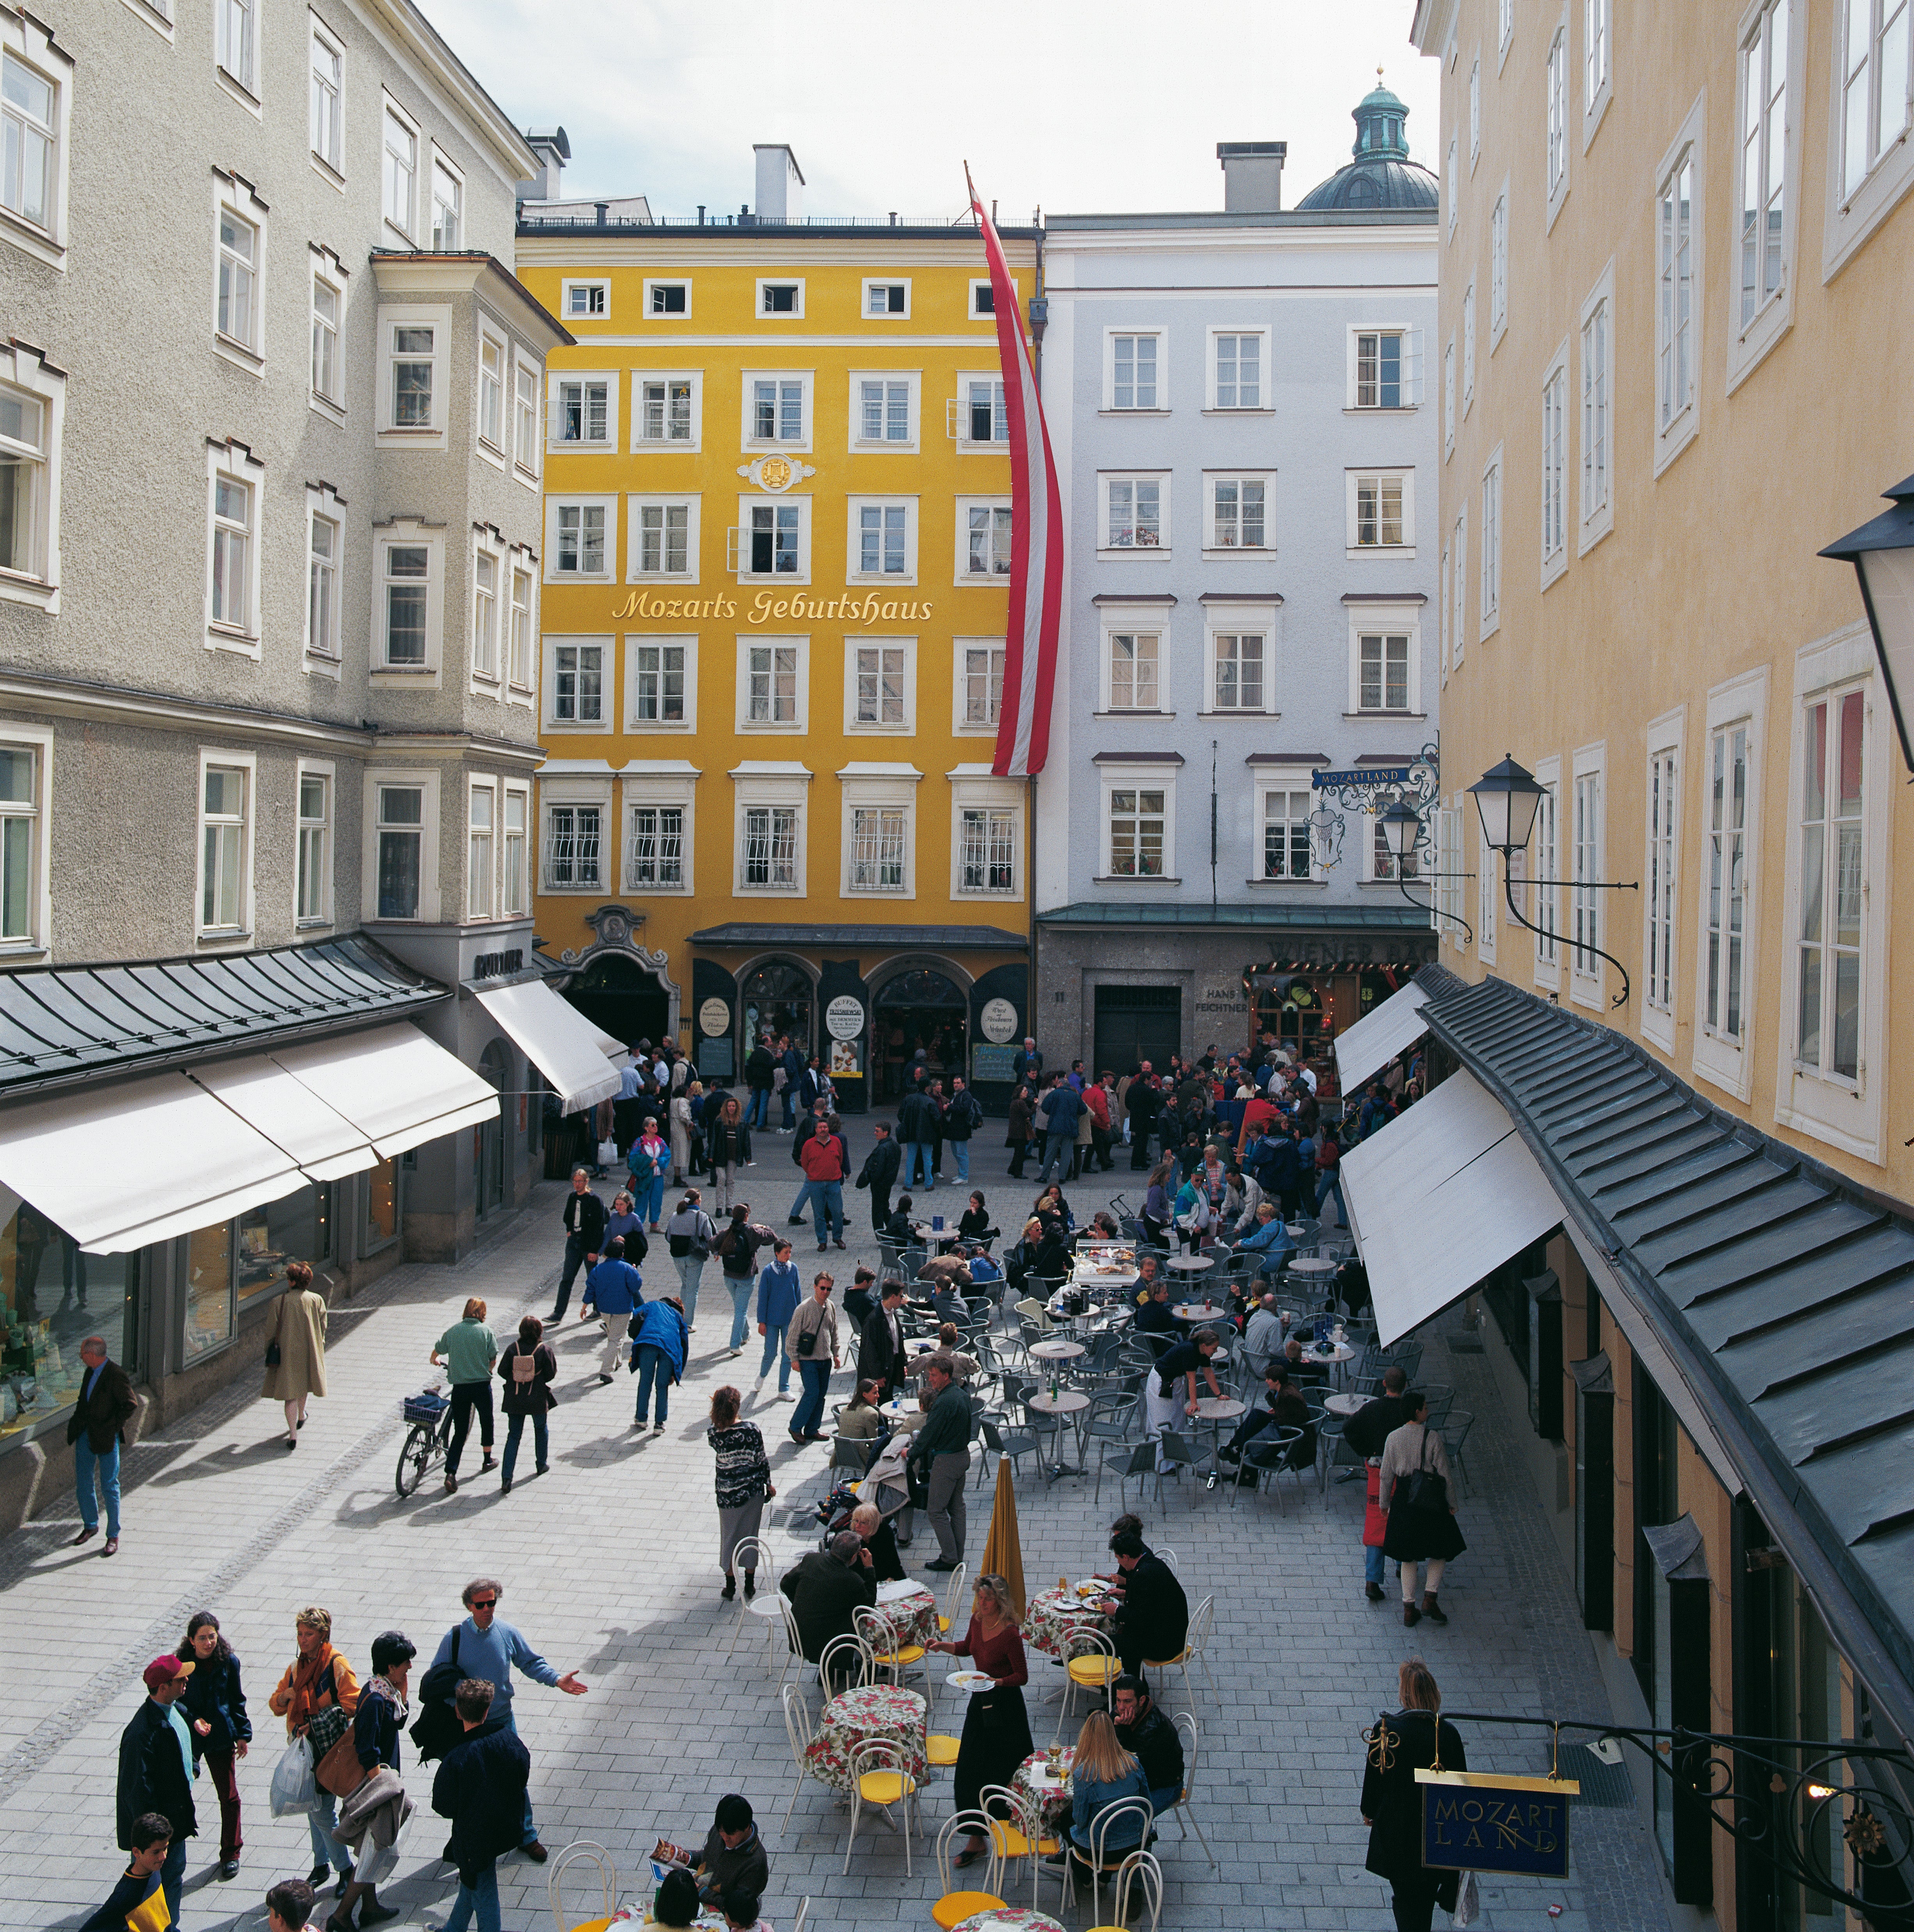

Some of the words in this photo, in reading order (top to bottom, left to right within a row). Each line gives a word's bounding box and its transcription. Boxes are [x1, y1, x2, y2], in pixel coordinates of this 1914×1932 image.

[612, 591, 737, 618] Mozarts
[747, 590, 933, 626] Geburtshaus
[1268, 941, 1373, 964] WIENER
[1055, 991, 1064, 1002] 11
[1207, 989, 1235, 999] HANS
[834, 999, 858, 1008] BUFFET
[1195, 1003, 1247, 1012] FEICHTNER
[1435, 1798, 1558, 1828] MOZART
[1435, 1822, 1558, 1852] LAND
